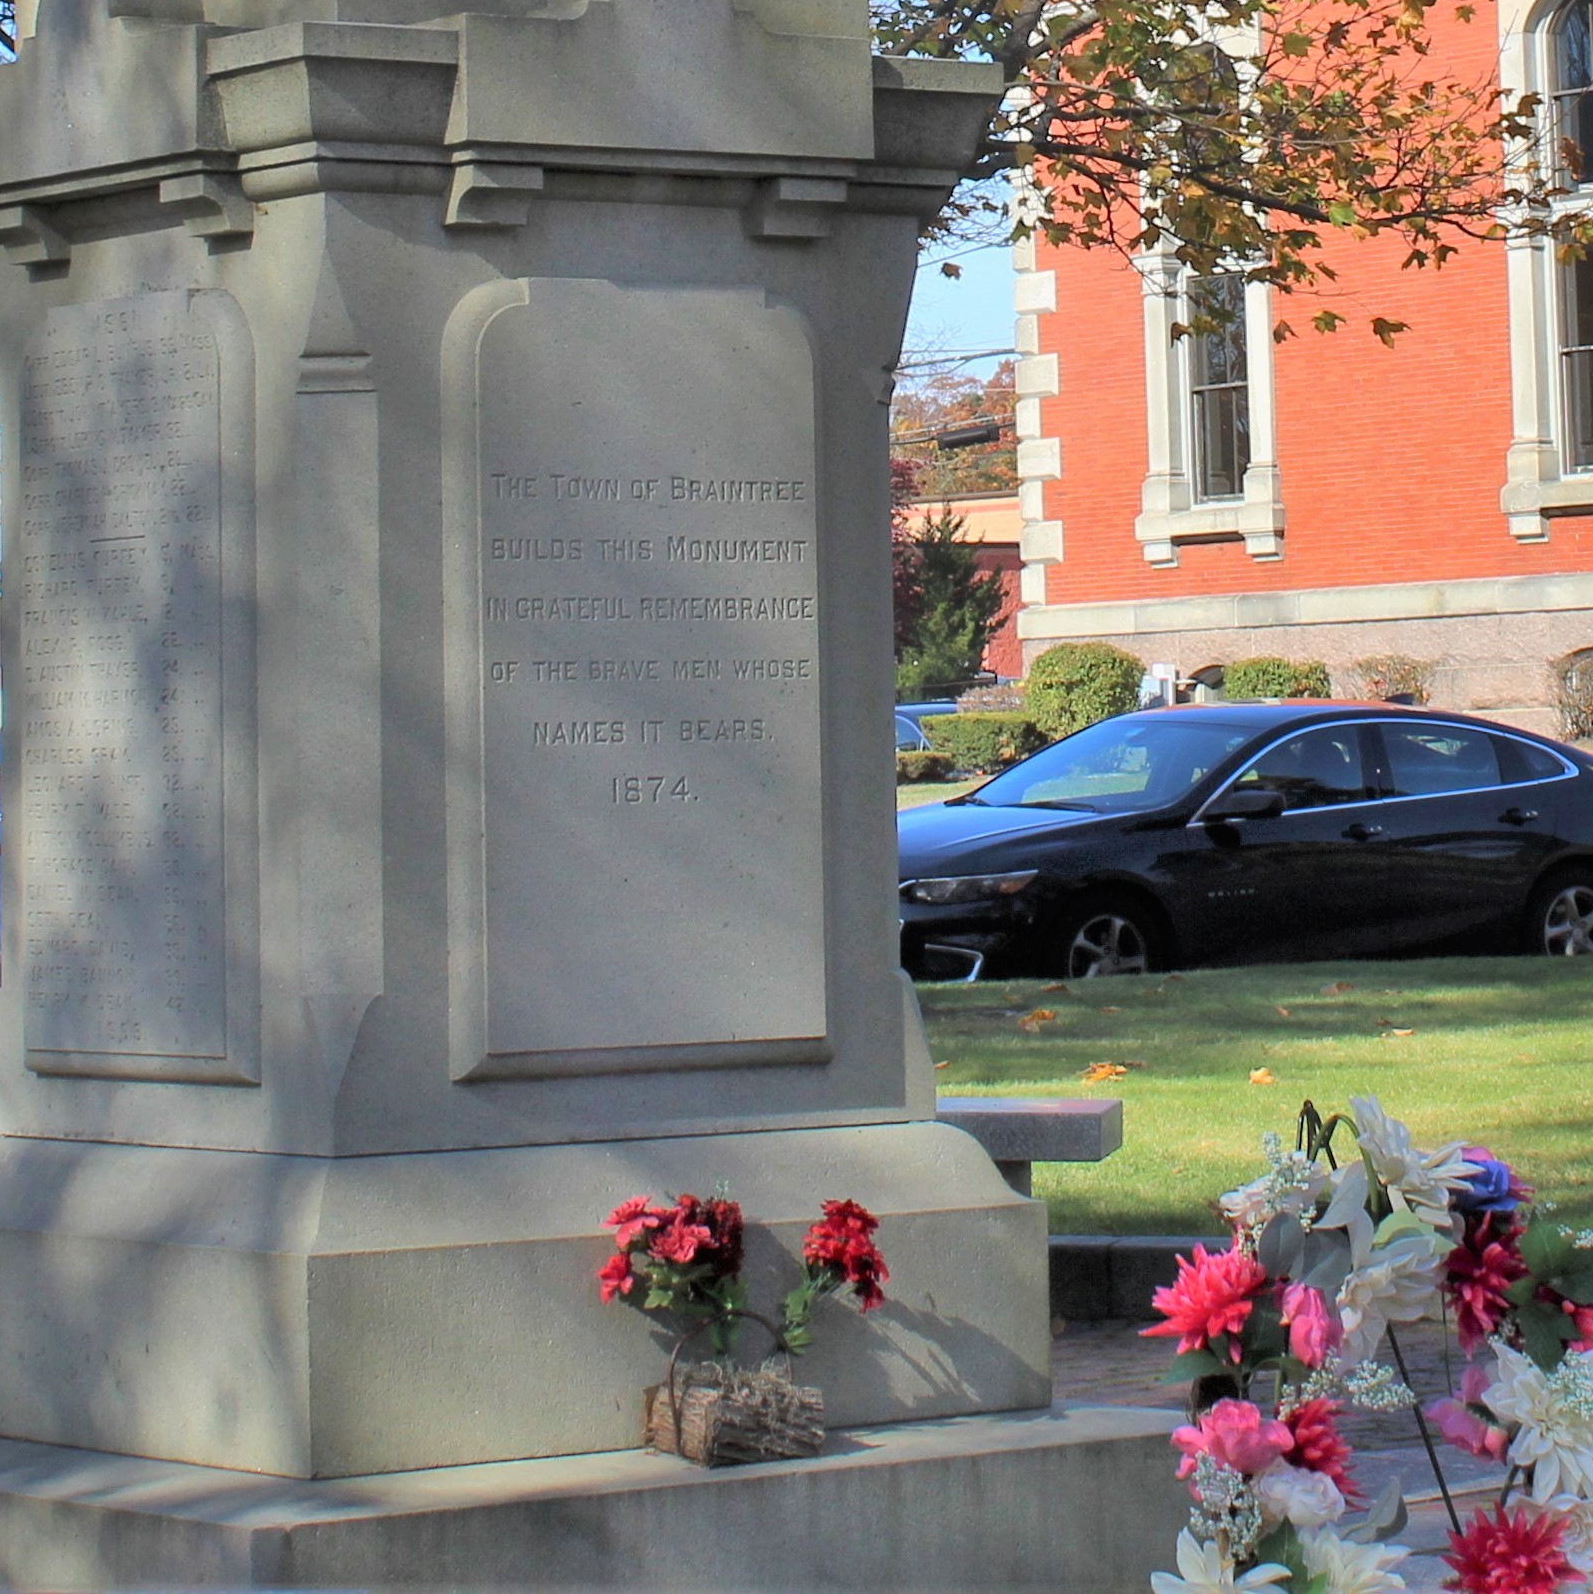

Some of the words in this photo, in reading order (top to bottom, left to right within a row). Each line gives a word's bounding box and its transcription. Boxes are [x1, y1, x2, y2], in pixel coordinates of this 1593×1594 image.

[491, 473, 538, 500] THE
[550, 474, 620, 501] TOWN
[631, 478, 660, 501] OF
[670, 476, 805, 502] BRAINTREE
[492, 538, 583, 561] BUILDS
[596, 538, 653, 562] THIS
[667, 536, 808, 563] MONUMENT
[487, 598, 508, 621] IN
[516, 598, 632, 621] GRATEFUL
[640, 597, 815, 621] REMEMBRANCE
[491, 661, 519, 683] OF
[532, 661, 578, 682] THE
[590, 660, 660, 681] BRAVE
[673, 660, 721, 681] MEN
[733, 659, 811, 680] WHOSE
[533, 721, 626, 746] NAMES
[640, 721, 664, 743] IT
[679, 719, 776, 742] BEARS.
[612, 776, 700, 804] 1874.
